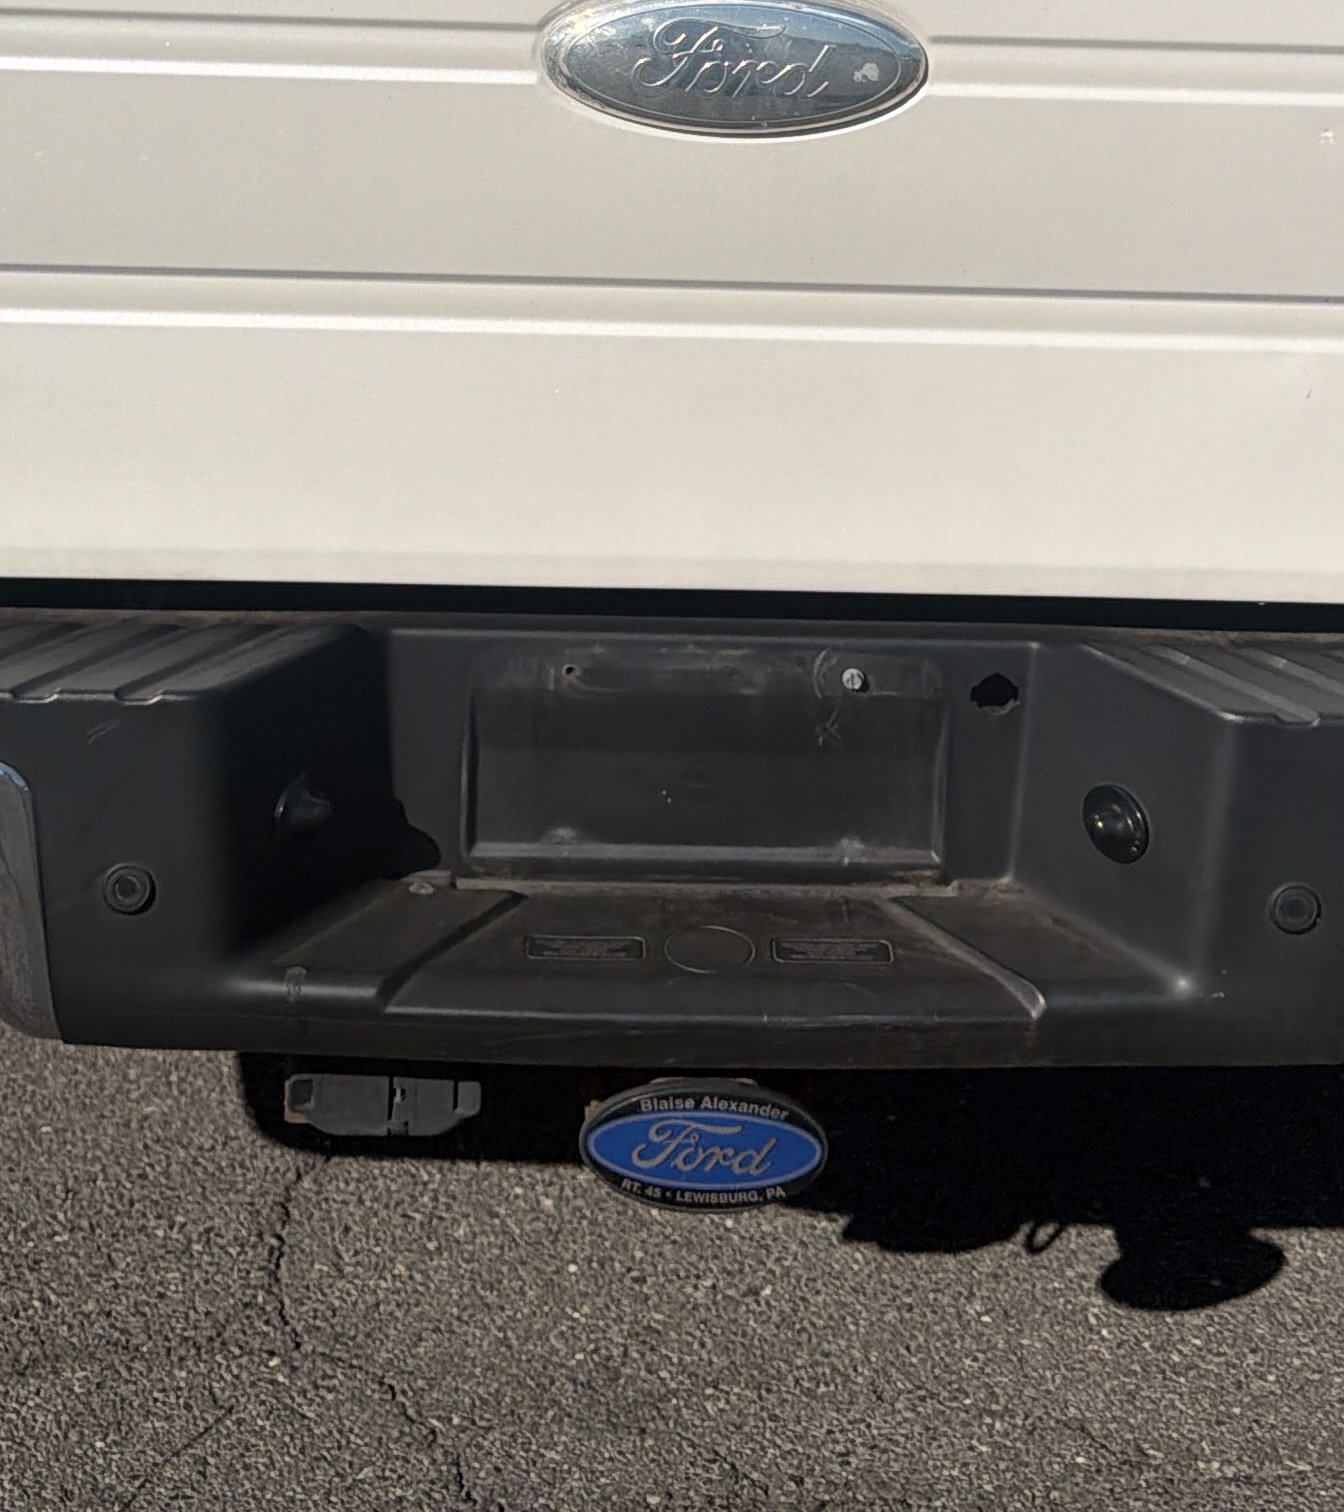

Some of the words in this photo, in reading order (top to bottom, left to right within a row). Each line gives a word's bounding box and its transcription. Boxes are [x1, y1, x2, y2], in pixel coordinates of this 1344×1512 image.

[631, 18, 836, 99] Ford
[640, 1096, 695, 1112] Blaise
[699, 1095, 789, 1120] Alexander
[631, 1119, 777, 1176] Ford
[646, 1185, 662, 1198] 45
[766, 1185, 786, 1199] PA
